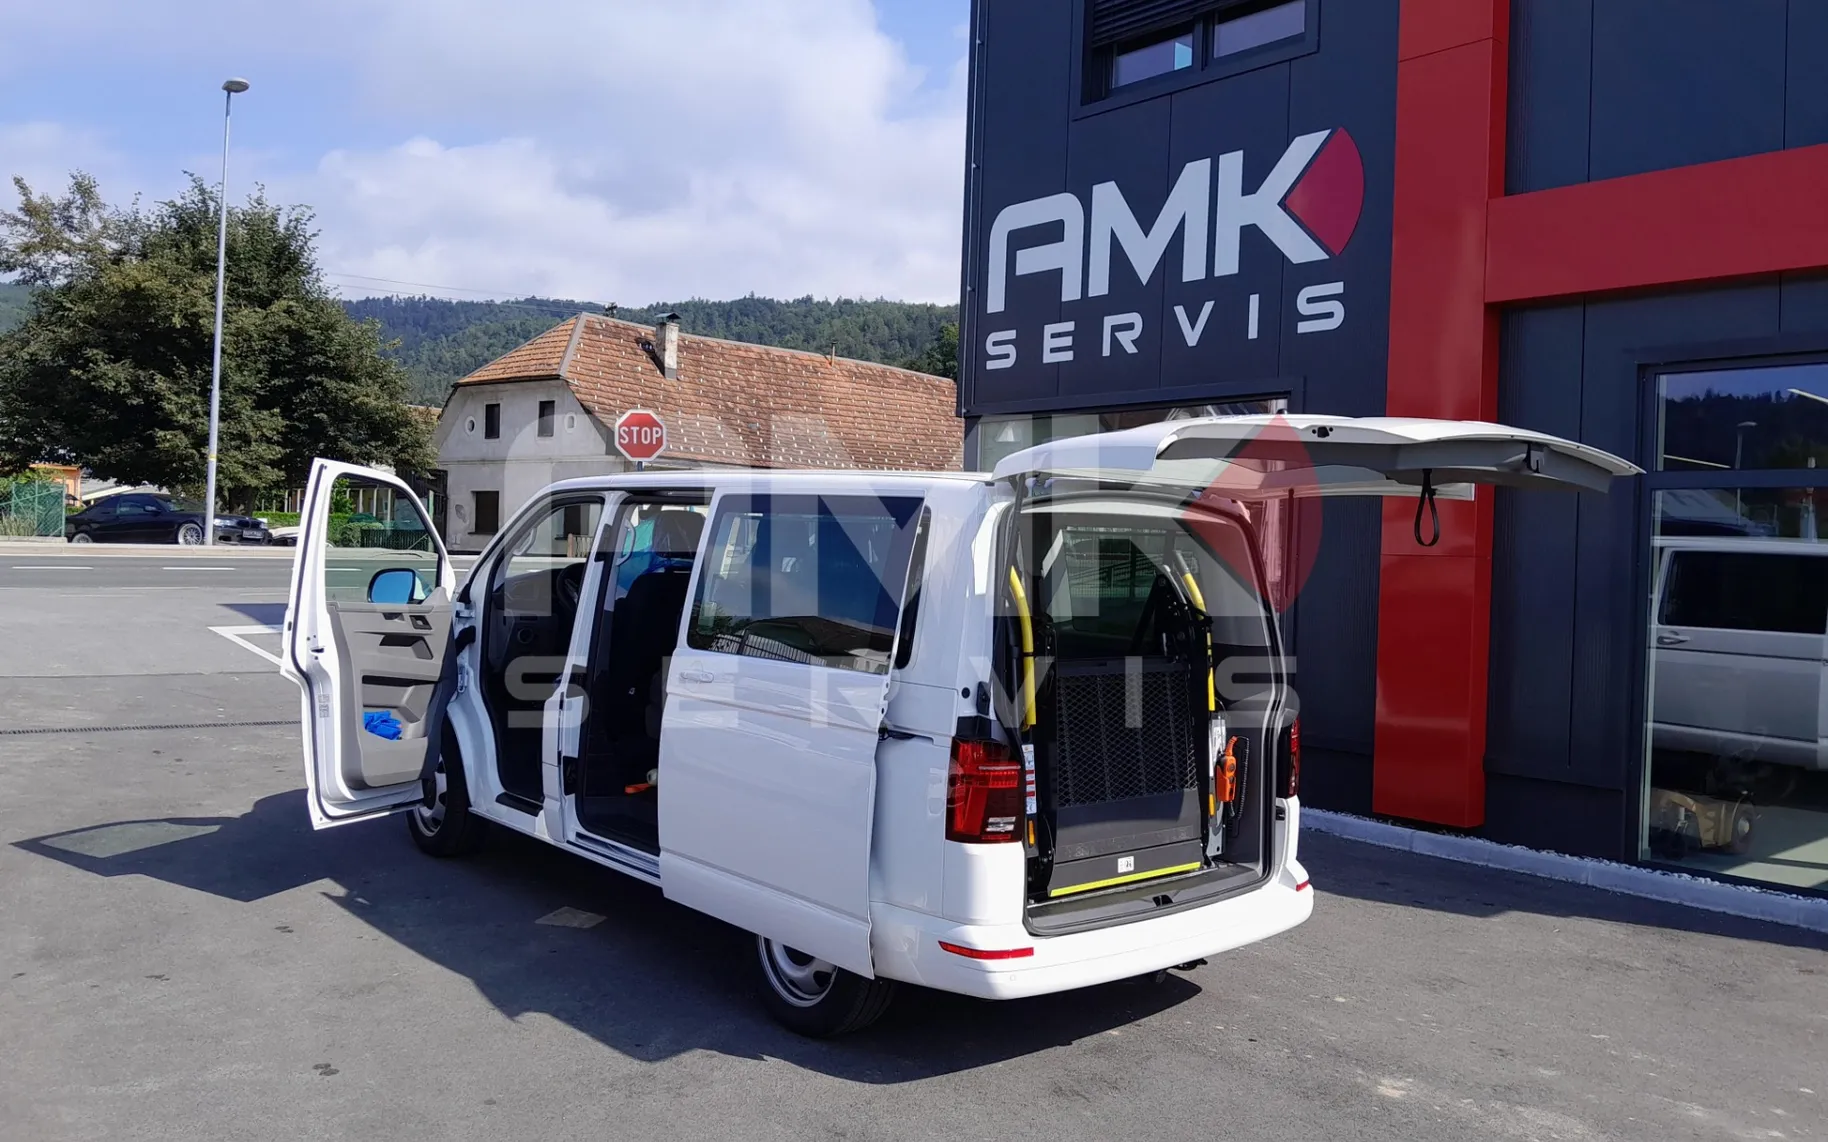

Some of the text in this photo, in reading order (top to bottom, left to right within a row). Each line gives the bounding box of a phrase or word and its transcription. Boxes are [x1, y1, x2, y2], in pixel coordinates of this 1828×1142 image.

[986, 127, 1332, 314] AMK
[985, 281, 1346, 370] SERVIS
[619, 426, 662, 445] STOP
